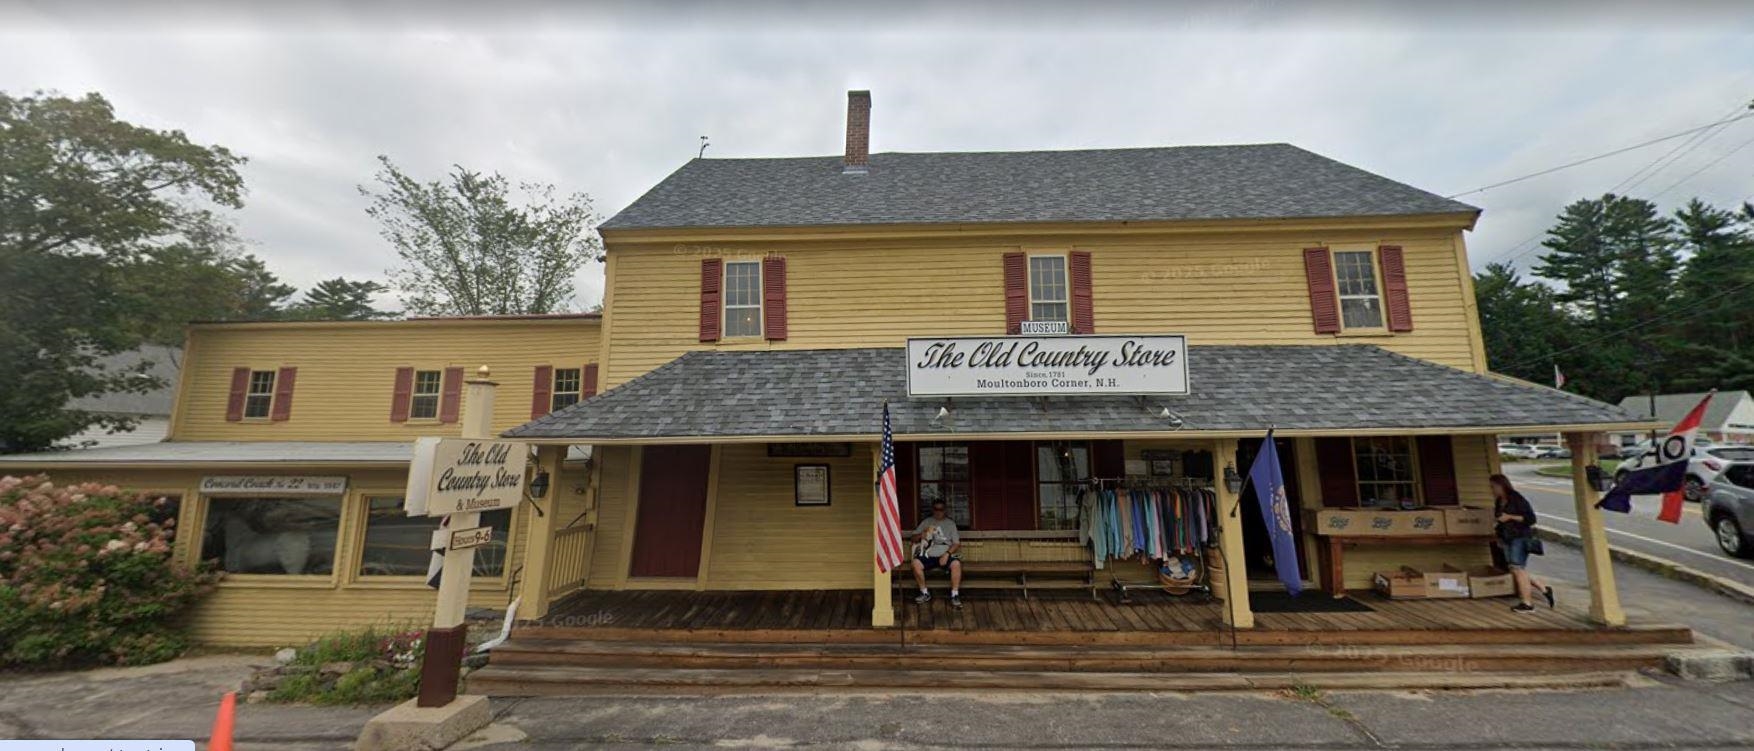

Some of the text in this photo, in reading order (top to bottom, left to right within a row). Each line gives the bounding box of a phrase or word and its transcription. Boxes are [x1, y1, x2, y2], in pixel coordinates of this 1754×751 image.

[1023, 322, 1067, 333] MUSEUM
[917, 340, 1176, 376] The Old Country Store
[977, 378, 1120, 389] Moultonboro Corner, N.H.
[457, 442, 512, 466] The Old
[436, 467, 521, 496] Country Store
[455, 498, 501, 511] & Museum
[475, 531, 490, 544] 9-6
